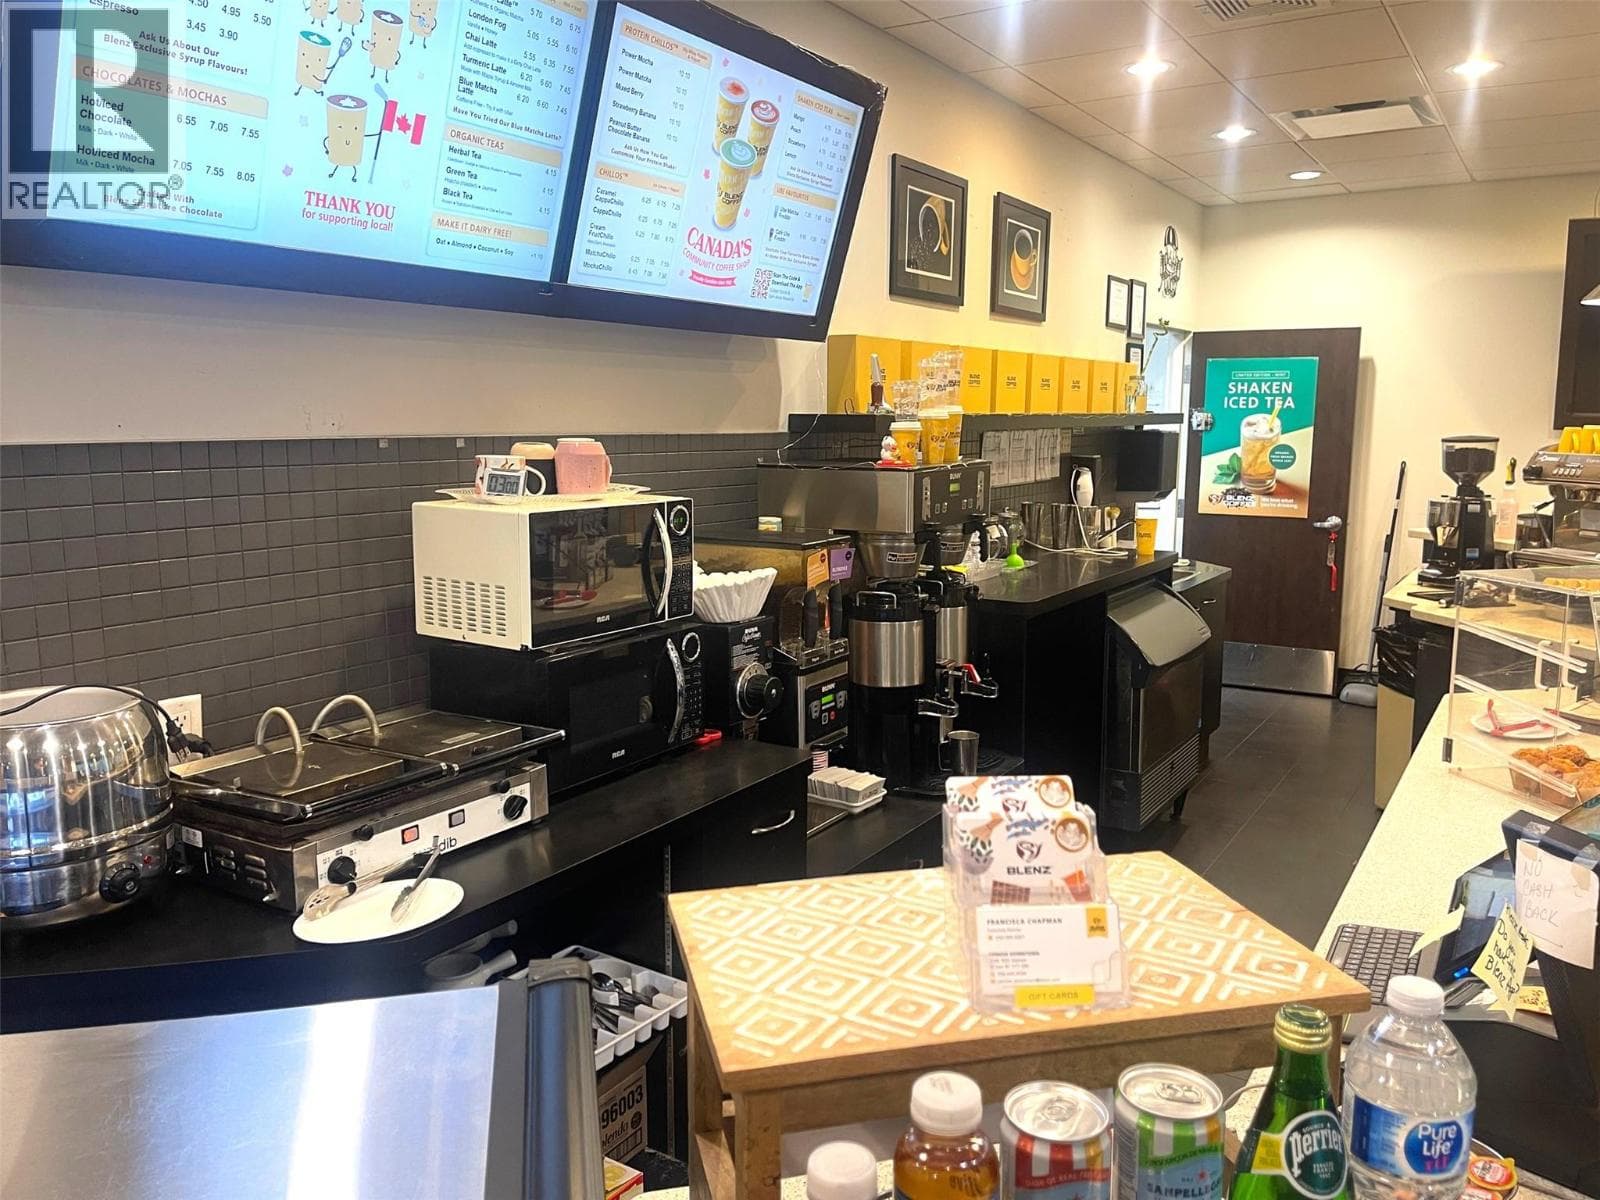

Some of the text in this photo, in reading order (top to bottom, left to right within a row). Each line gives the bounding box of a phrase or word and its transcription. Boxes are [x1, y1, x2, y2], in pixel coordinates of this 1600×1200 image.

[221, 4, 272, 26] 4.95 5.50
[468, 8, 507, 31] London Fog
[186, 19, 239, 41] 3.45 3.90
[624, 24, 650, 42] PROTEIN
[139, 30, 220, 58] Ask Us About Our
[465, 31, 498, 49] Chai Latte
[103, 33, 249, 76] Blenz Exclusive Syrup Flavours!
[462, 53, 490, 71] Turmeric
[491, 63, 507, 75] Latte
[621, 48, 654, 67] Power Mocha
[618, 65, 652, 84] Power Matcha
[82, 65, 163, 92] CHOCOLATES
[177, 86, 228, 107] MOCHAS
[457, 85, 474, 96] Latte
[458, 75, 474, 87] Blue
[474, 81, 498, 95] Matcha
[615, 81, 645, 100] Mixed Berry
[79, 109, 133, 128] Chocolate
[612, 99, 657, 121] Strawberry Banana
[176, 113, 260, 139] 6.55 7.05 7.55
[453, 105, 468, 116] Have
[470, 111, 482, 120] You
[483, 114, 498, 125] Tried
[498, 119, 510, 128] Our
[510, 122, 524, 132] Blue
[524, 126, 545, 138] Matcha
[545, 131, 562, 141] Latte?
[608, 116, 642, 132] Peanut Butter
[449, 129, 505, 150] ORGANIC TEAS
[607, 125, 651, 144] Chocolate Banana
[122, 151, 155, 167] Mocha
[448, 144, 482, 160] Herbal Tea
[173, 159, 256, 183] 7.05 7.55 8.05
[445, 166, 466, 178] Green
[467, 170, 478, 180] Tea
[173, 193, 195, 205] With
[442, 186, 473, 201] Black Tea
[179, 205, 223, 219] Chocolate
[304, 190, 396, 219] THANK YOU
[302, 207, 393, 232] for supporting local!
[436, 217, 512, 239] MAKE IT DAIRY FREE!
[589, 221, 607, 231] Cream
[435, 236, 514, 257] Oat Almond Coconut Soy
[687, 226, 752, 259] CANADA'S
[682, 247, 716, 271] COMMUNITY
[715, 263, 736, 272] COFFEE
[1228, 381, 1293, 395] SHAKEN
[1223, 396, 1296, 409] ICED TEA
[596, 614, 610, 623] RCA
[611, 748, 626, 760] RCA
[1006, 866, 1052, 876] BLENZ
[1523, 861, 1543, 877] NO
[1523, 881, 1553, 898] CASH
[1524, 903, 1560, 927] BACK
[1028, 991, 1079, 1001] GIFT CARDS
[601, 1084, 644, 1130] 96003
[1418, 1124, 1457, 1142] Pure
[1422, 1141, 1453, 1160] Life
